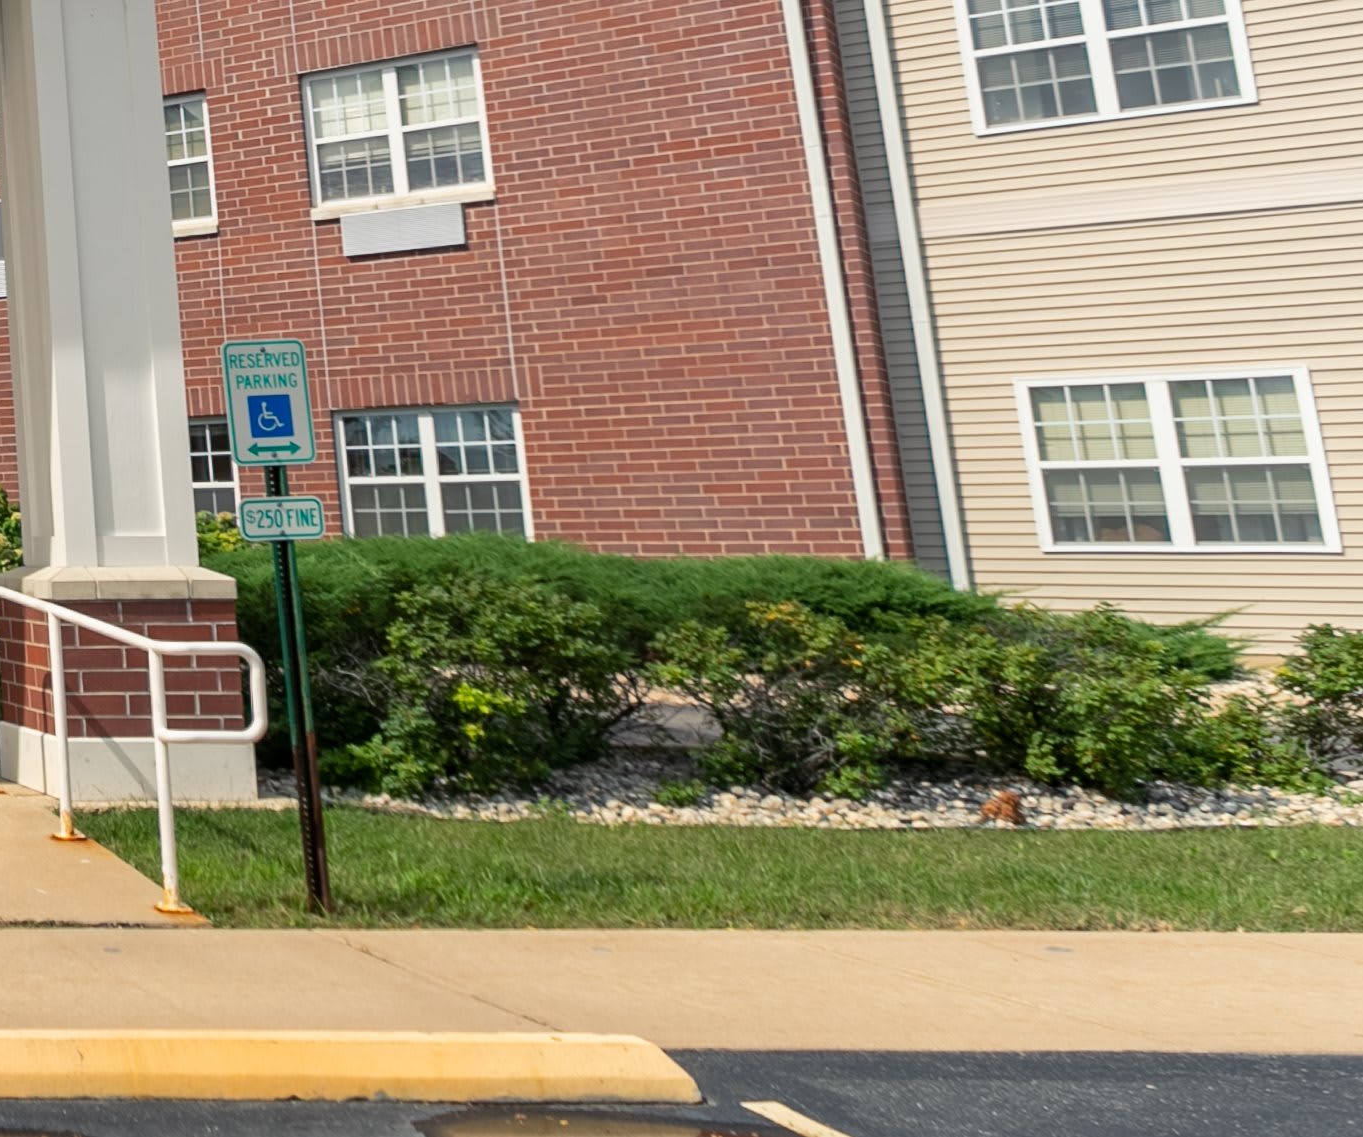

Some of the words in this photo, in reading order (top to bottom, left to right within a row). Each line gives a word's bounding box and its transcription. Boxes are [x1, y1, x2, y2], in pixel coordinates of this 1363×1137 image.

[228, 351, 300, 369] RESERVED
[235, 372, 298, 389] PARKING
[245, 508, 284, 529] $250
[286, 507, 318, 527] FINE
